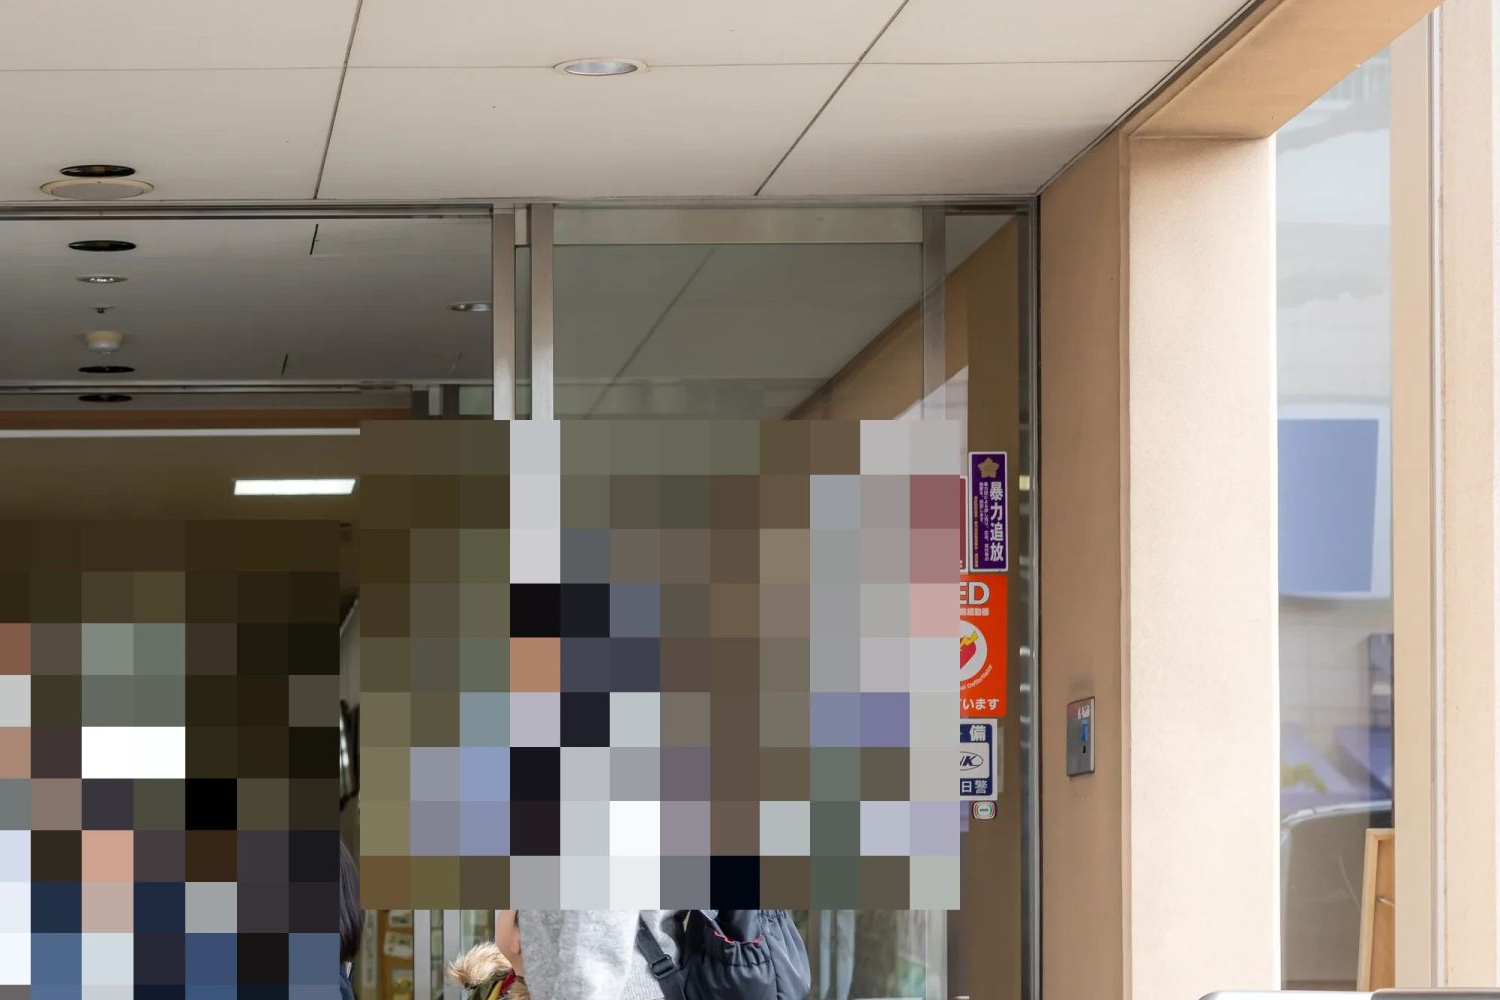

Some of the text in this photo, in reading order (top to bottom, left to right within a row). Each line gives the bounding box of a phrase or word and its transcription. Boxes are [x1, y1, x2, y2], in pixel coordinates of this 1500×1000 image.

[990, 481, 1004, 562] 暴力追放
[960, 582, 990, 605] ED
